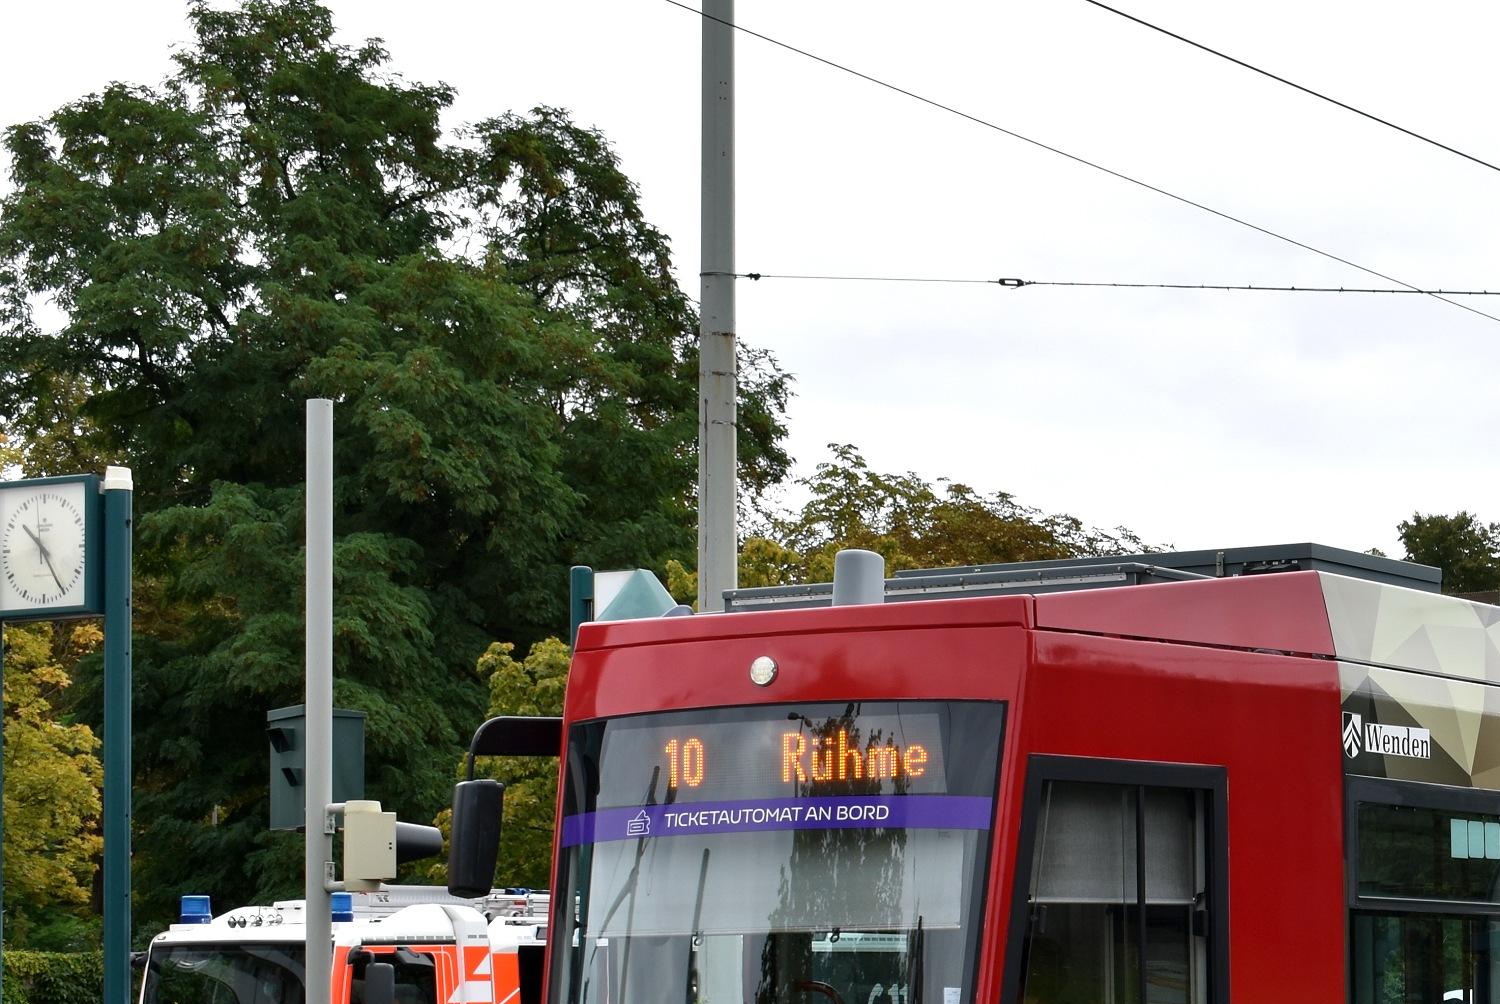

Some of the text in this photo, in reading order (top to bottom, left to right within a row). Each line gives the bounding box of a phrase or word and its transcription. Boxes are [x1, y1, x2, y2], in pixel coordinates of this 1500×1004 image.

[1366, 724, 1430, 758] Wenden
[665, 729, 927, 788] 10 Rühme
[664, 805, 889, 828] TICKETAUTOMAT AN BORD
